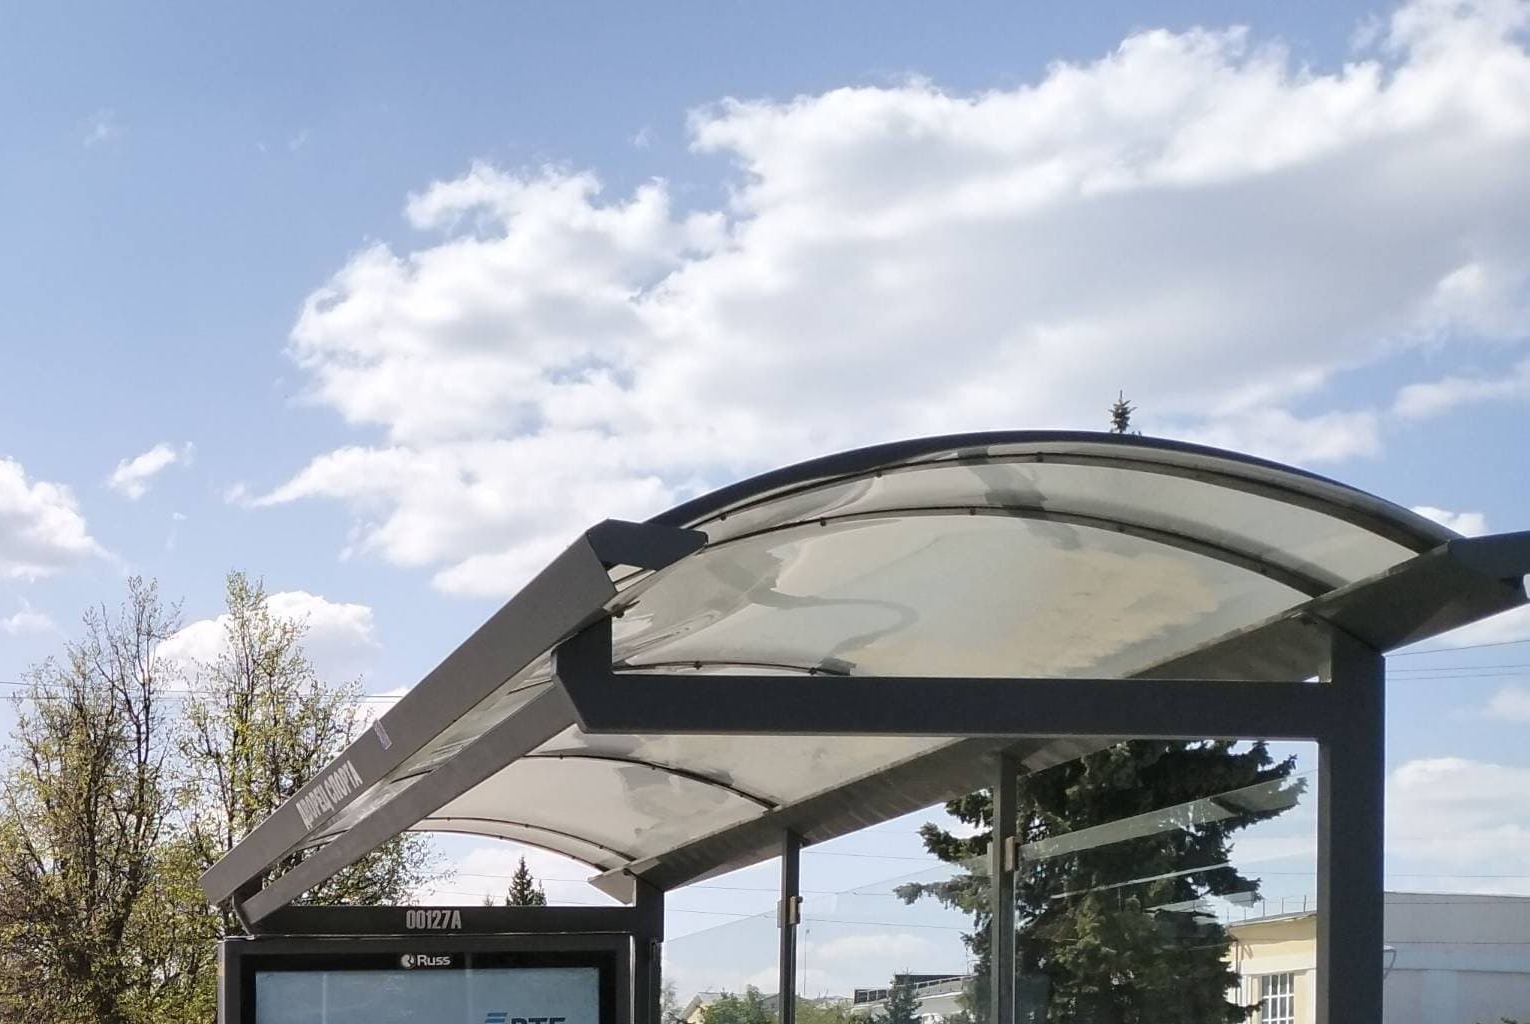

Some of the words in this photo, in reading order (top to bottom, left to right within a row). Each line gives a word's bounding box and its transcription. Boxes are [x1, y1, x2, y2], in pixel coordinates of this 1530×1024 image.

[295, 784, 335, 831] ДВОРЕЦ
[323, 760, 363, 804] СПОРТА
[417, 954, 451, 967] Russ
